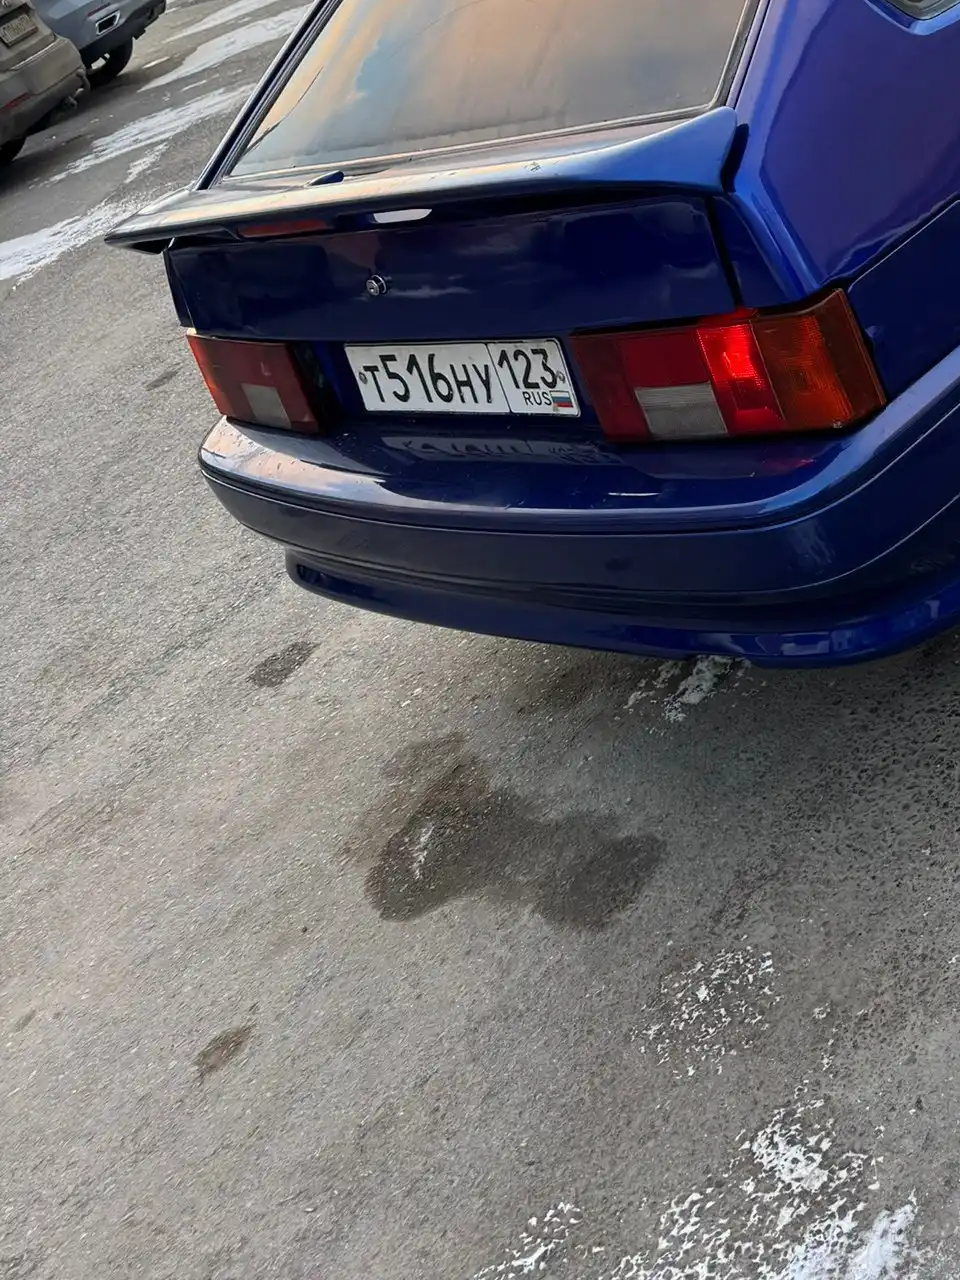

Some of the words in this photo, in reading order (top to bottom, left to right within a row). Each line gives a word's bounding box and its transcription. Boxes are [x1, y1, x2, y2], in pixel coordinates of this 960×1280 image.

[362, 353, 493, 404] Т516НУ
[497, 348, 558, 390] 123
[522, 391, 552, 406] RUS
